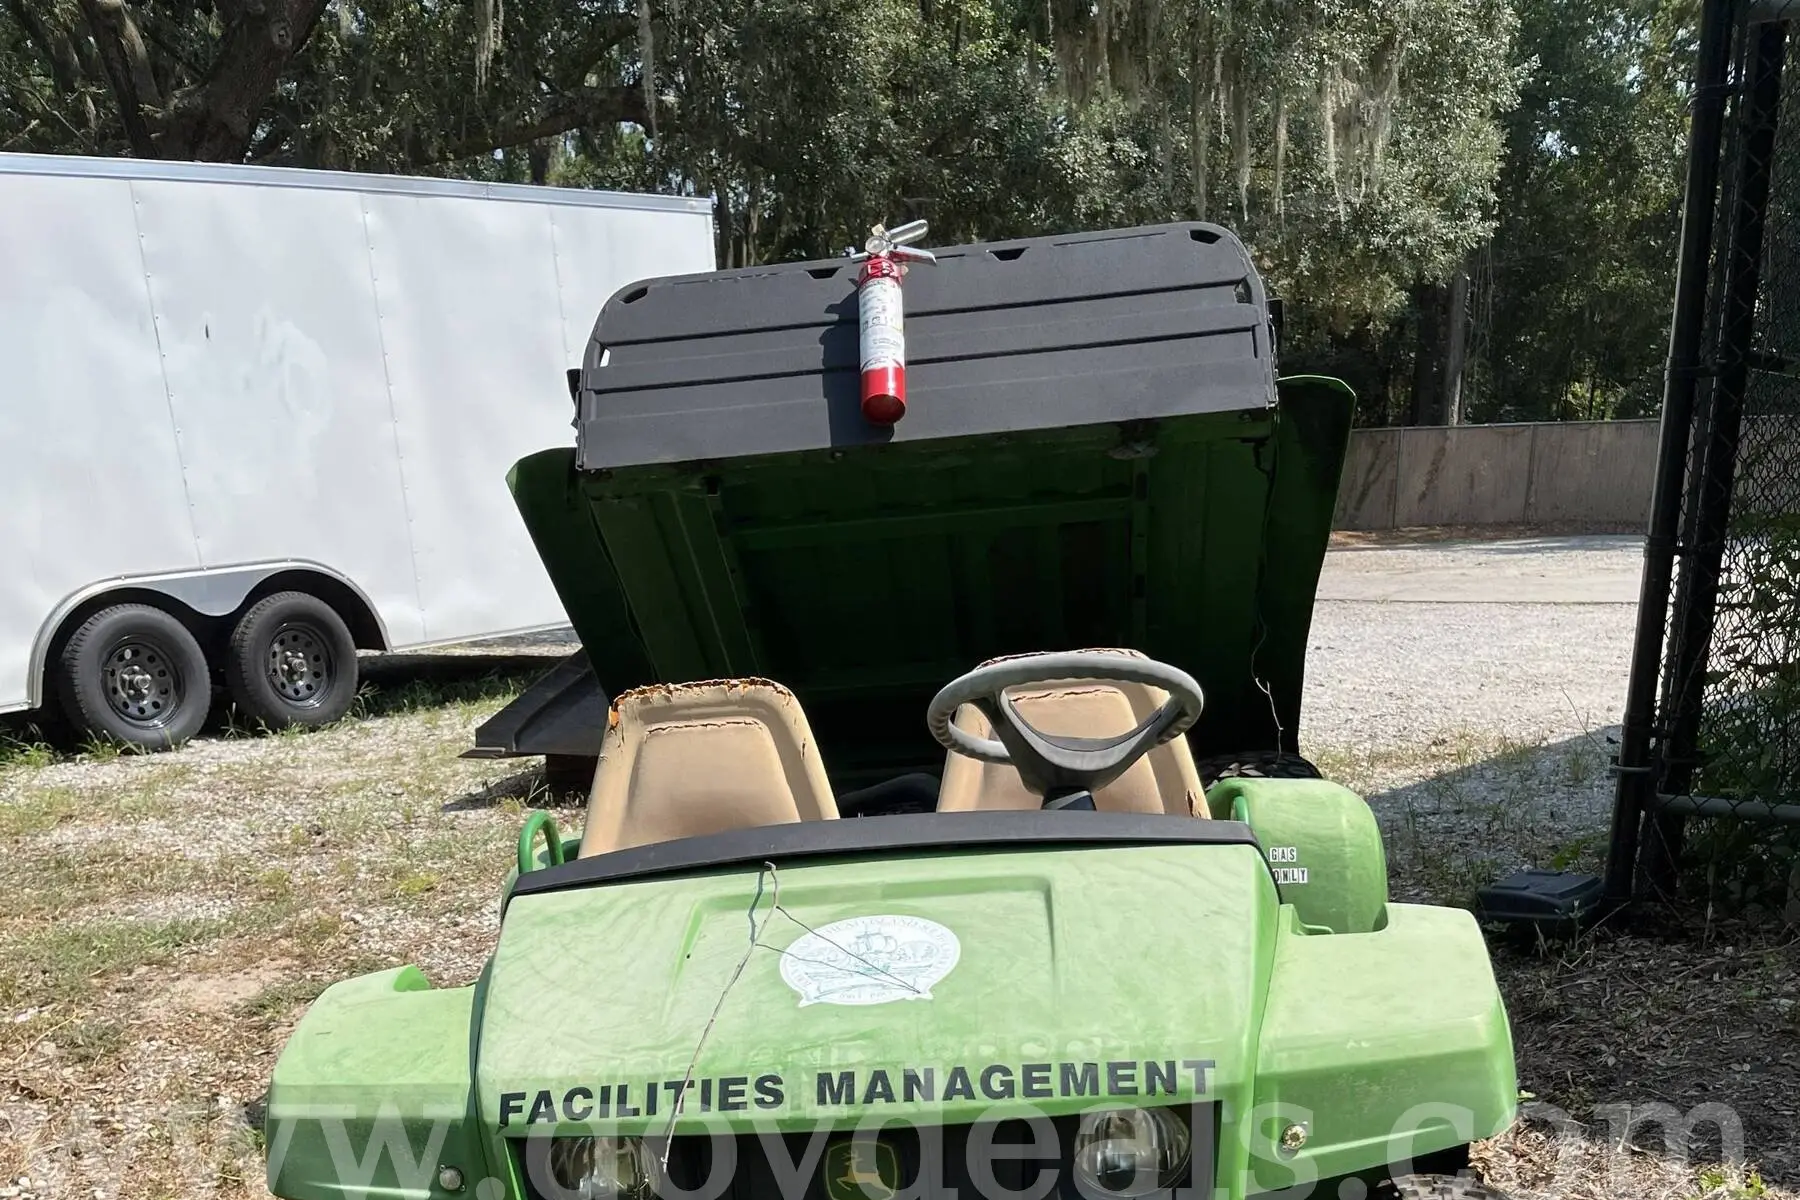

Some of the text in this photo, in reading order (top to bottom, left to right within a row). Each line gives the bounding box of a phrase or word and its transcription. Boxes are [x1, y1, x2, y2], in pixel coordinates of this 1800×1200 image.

[1271, 848, 1296, 861] GAS
[499, 1059, 1216, 1127] FACILITIES MANAGEMENT
